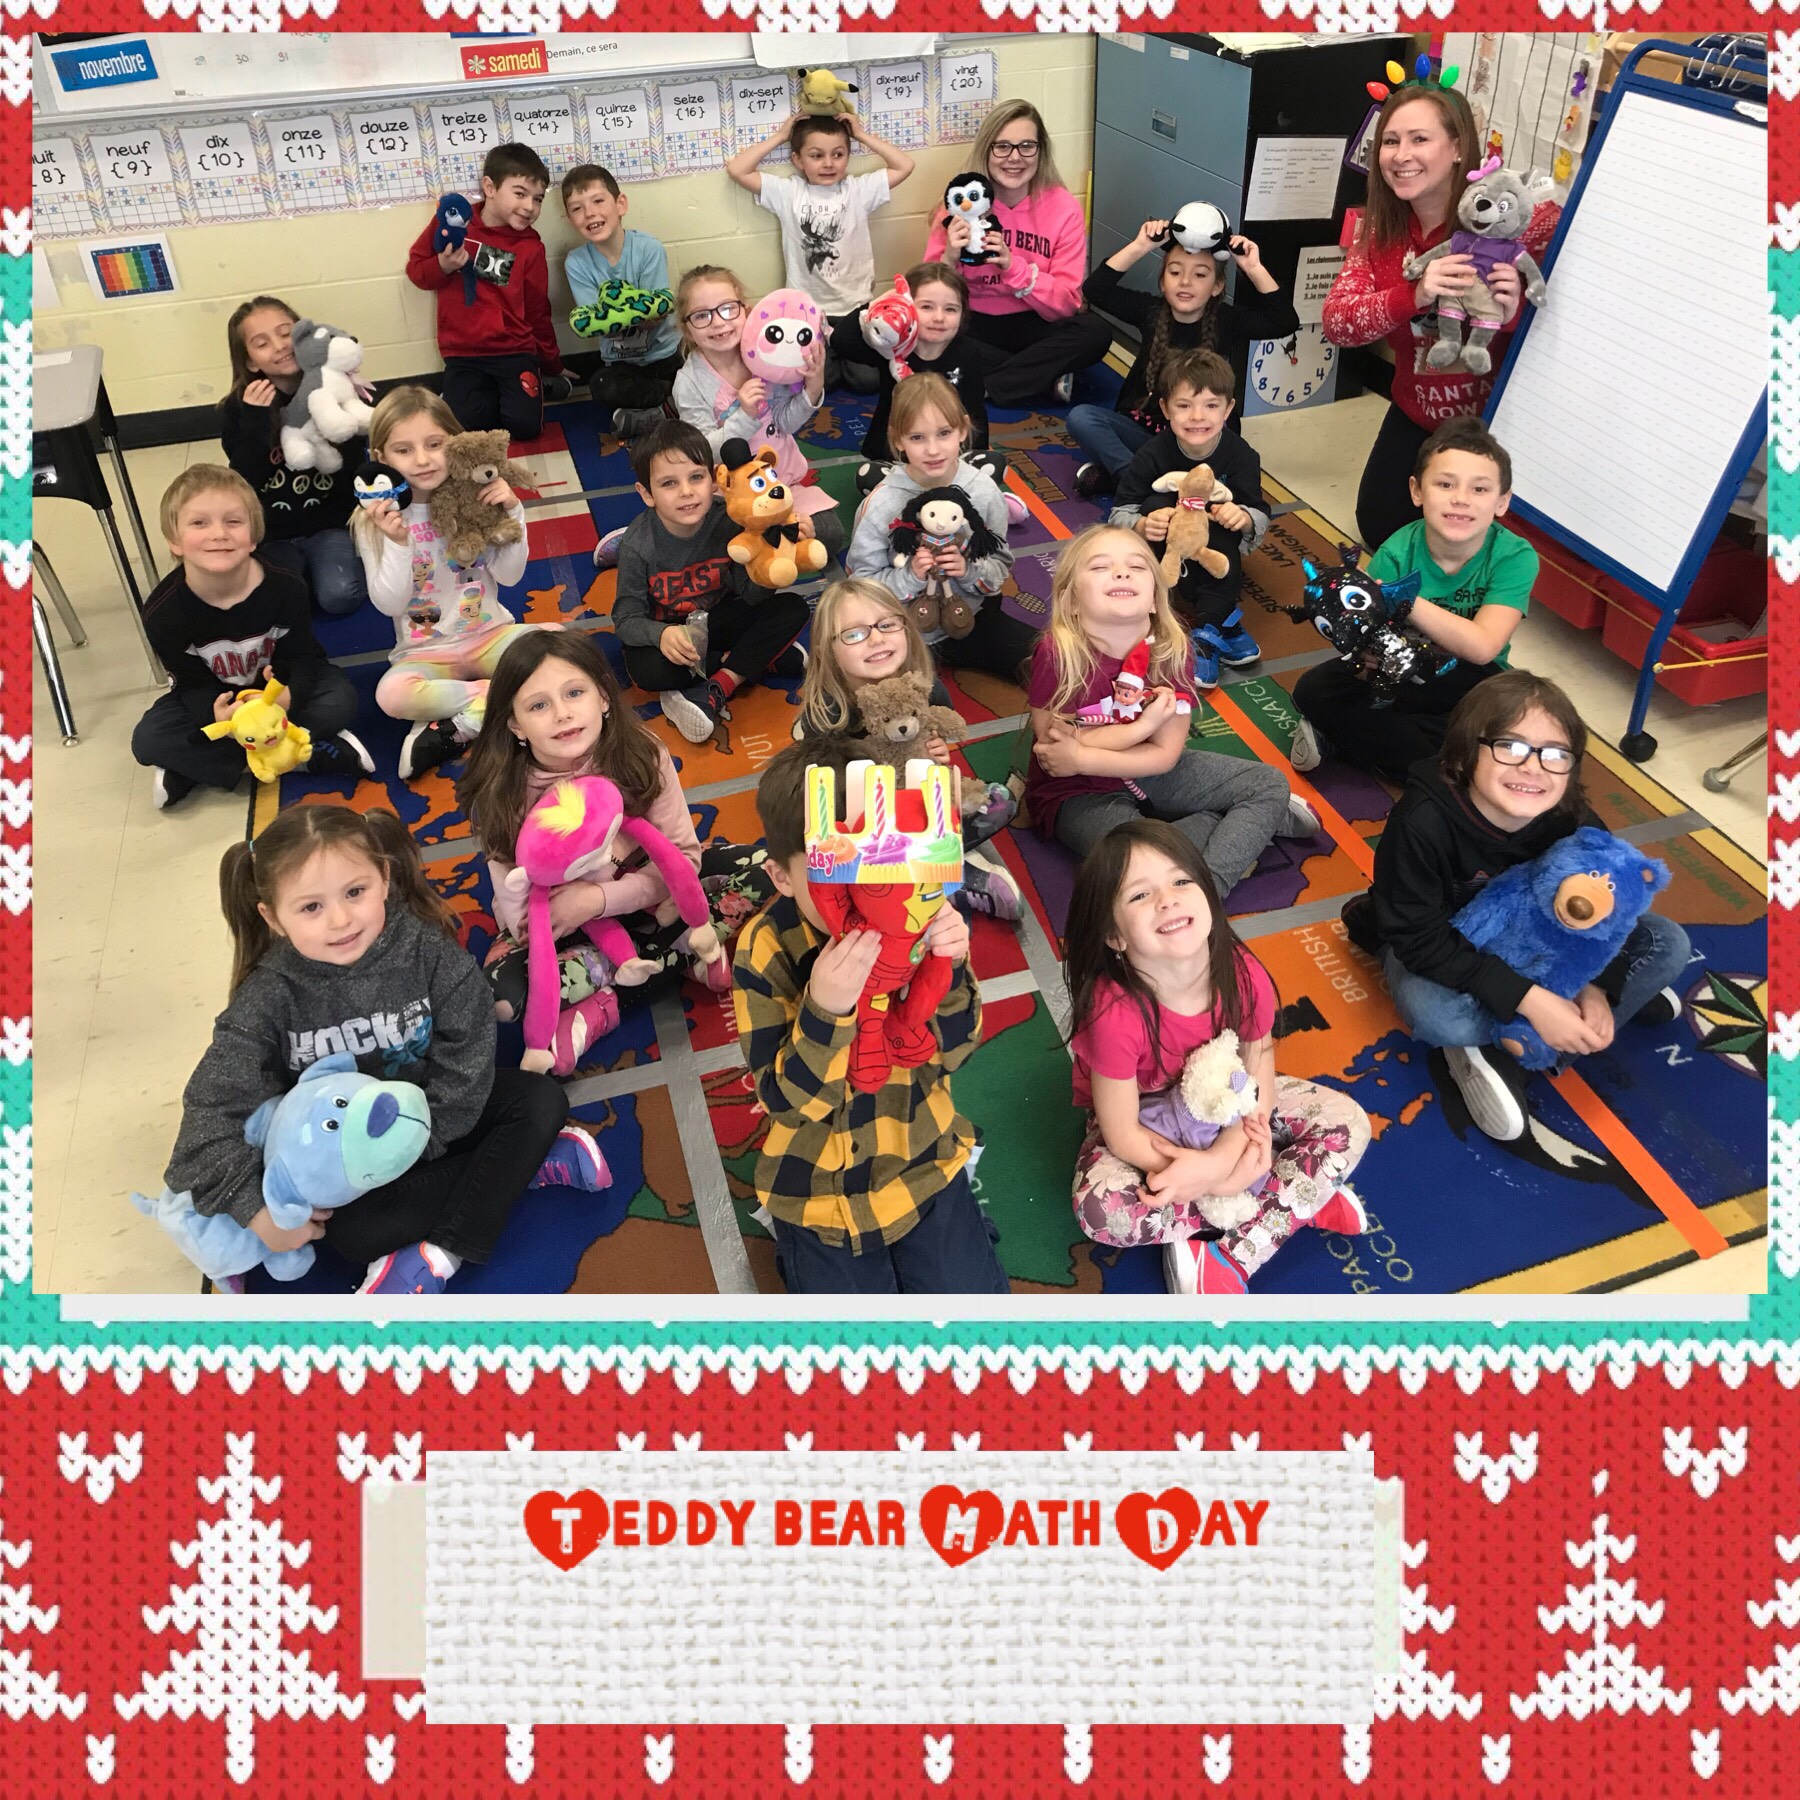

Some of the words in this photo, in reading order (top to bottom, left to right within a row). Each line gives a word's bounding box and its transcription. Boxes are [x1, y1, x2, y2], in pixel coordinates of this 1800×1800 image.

[546, 47, 584, 60] Demain,
[586, 45, 597, 53] ce
[599, 41, 618, 52] sera
[78, 51, 147, 80] novembre
[235, 55, 250, 64] 30
[489, 47, 541, 73] samedi
[954, 65, 979, 76] vingt
[876, 71, 921, 86] dix-neuf
[739, 85, 784, 99] dix-sept
[673, 94, 705, 106] seize
[514, 107, 570, 122] quatorze
[595, 103, 637, 116] quinze
[441, 111, 488, 127] treize
[360, 119, 410, 135] douze
[205, 135, 230, 149] dix
[281, 128, 323, 142] onze
[105, 140, 151, 157] neuf
[1015, 229, 1051, 259] BEND
[1262, 341, 1275, 356] 10
[1324, 348, 1333, 361] 3
[1254, 359, 1264, 373] 9
[1316, 368, 1325, 381] 4
[1258, 377, 1268, 391] 8
[1303, 382, 1312, 396] 5
[1271, 387, 1281, 401] 7
[1285, 390, 1295, 403] 6
[1414, 380, 1492, 403] SANTA
[1260, 543, 1296, 568] LAKE
[1292, 927, 1369, 1004] BRITISH
[1655, 1044, 1693, 1067] N
